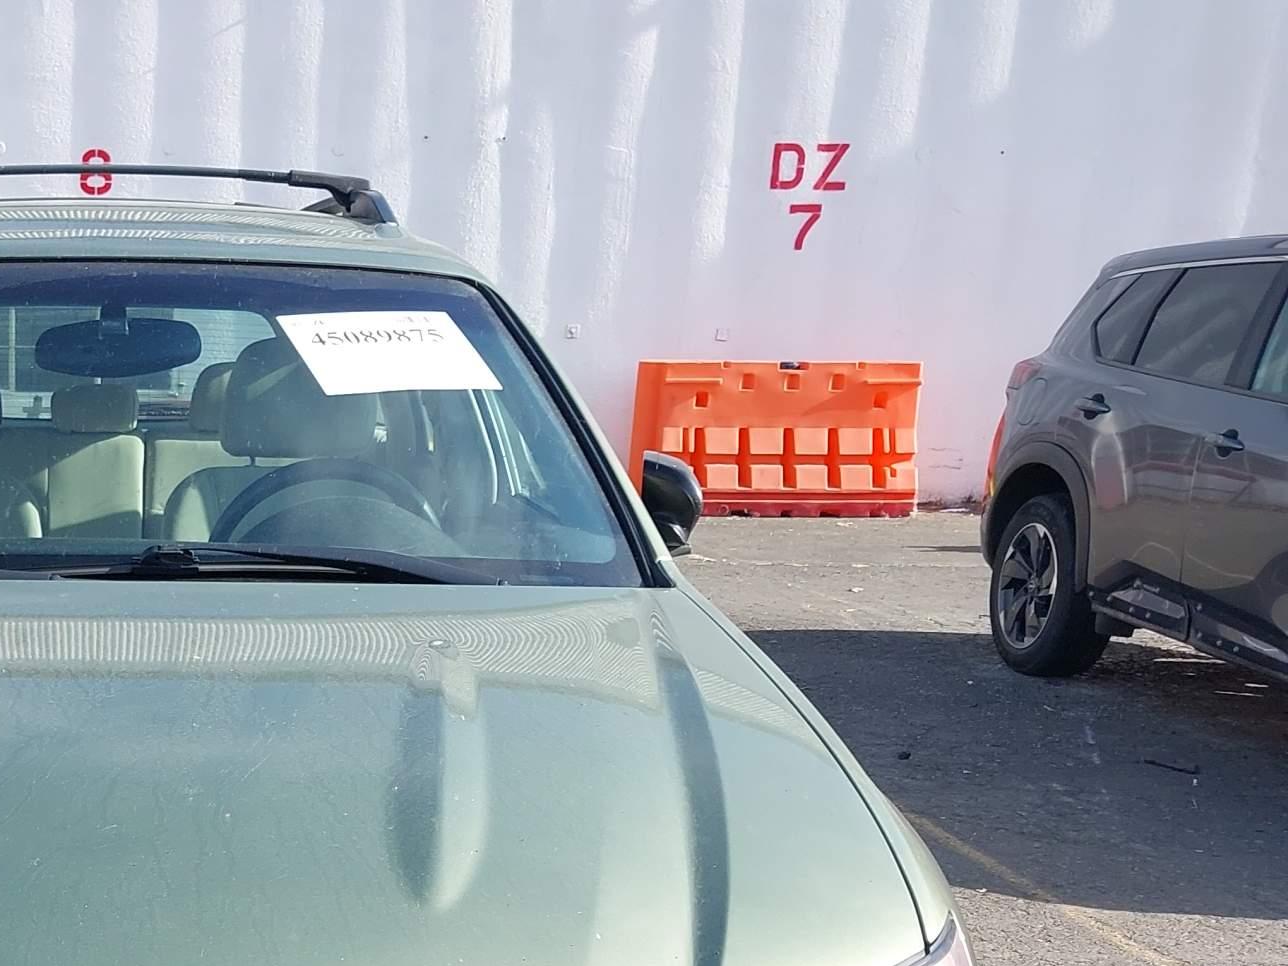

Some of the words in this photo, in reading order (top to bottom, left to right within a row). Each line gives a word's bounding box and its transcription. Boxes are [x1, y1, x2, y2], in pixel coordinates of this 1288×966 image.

[79, 148, 113, 196] 8
[769, 143, 851, 191] DZ
[789, 204, 823, 251] 7
[311, 328, 445, 347] 45089875
